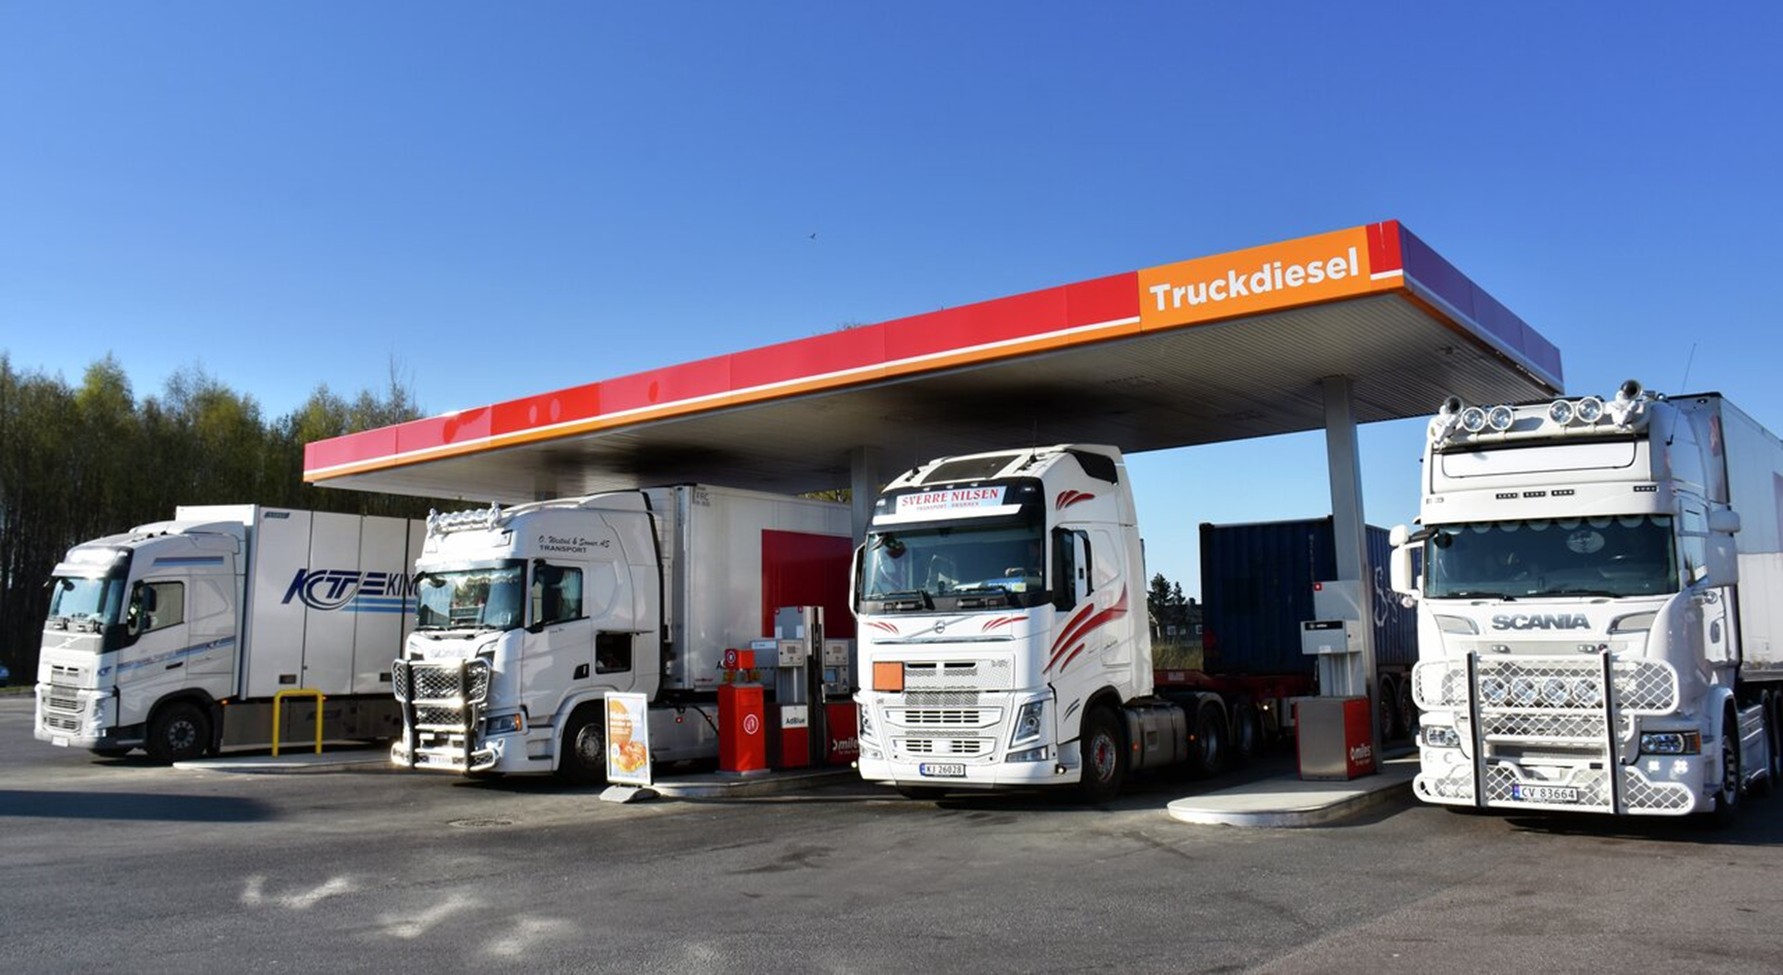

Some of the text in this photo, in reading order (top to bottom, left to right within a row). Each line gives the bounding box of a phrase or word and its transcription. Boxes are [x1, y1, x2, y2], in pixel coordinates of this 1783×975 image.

[1149, 246, 1359, 311] Truckdiesel
[902, 489, 999, 506] SVERRE NILSEN
[540, 545, 586, 553] TRANSPORT
[1491, 612, 1592, 631] SCANIA
[1522, 787, 1575, 799] CV 83664
